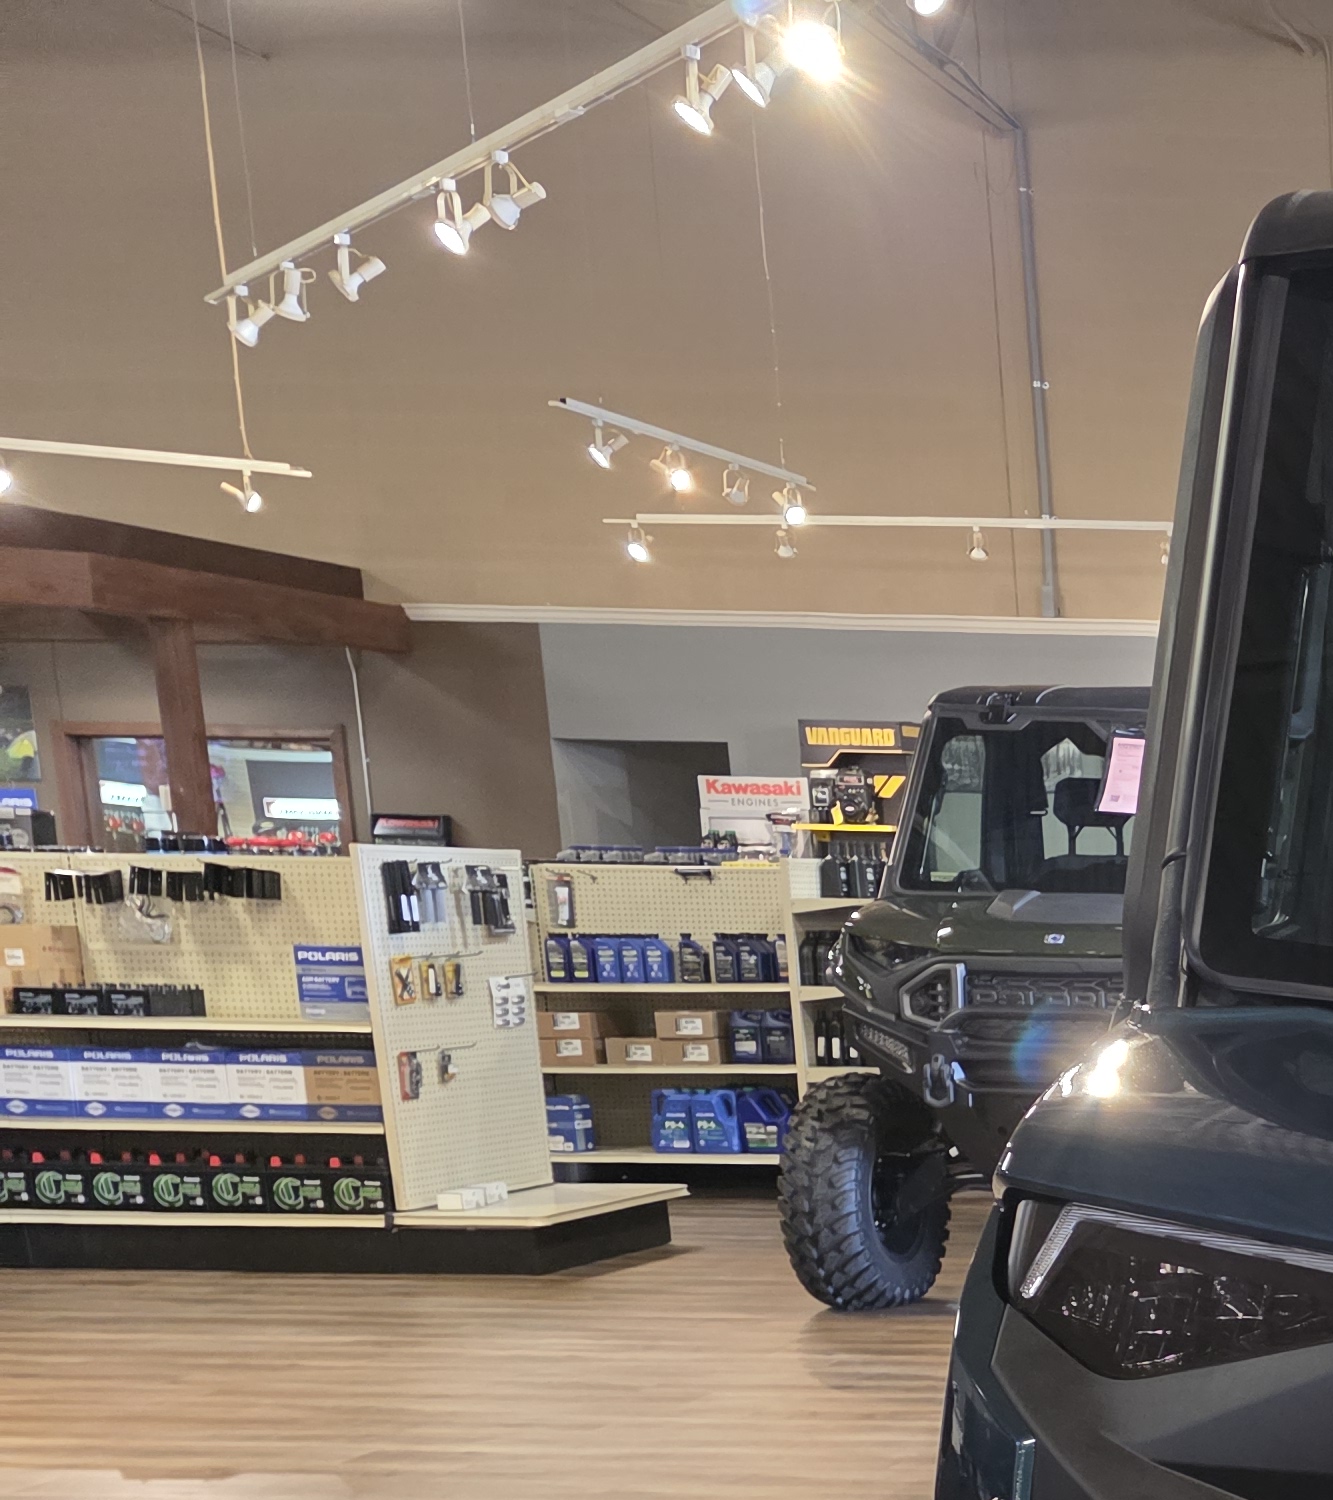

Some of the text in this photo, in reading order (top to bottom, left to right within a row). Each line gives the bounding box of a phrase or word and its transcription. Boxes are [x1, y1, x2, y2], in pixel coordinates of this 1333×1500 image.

[804, 726, 896, 747] VANGUARD
[705, 778, 802, 796] Kawasaki
[731, 798, 779, 807] ENGINES
[297, 950, 360, 962] POLARIS
[5, 1048, 54, 1059] POLARIS
[83, 1050, 132, 1060] POLARIS
[161, 1052, 209, 1063] POLARIS
[239, 1053, 287, 1063] POLARIS
